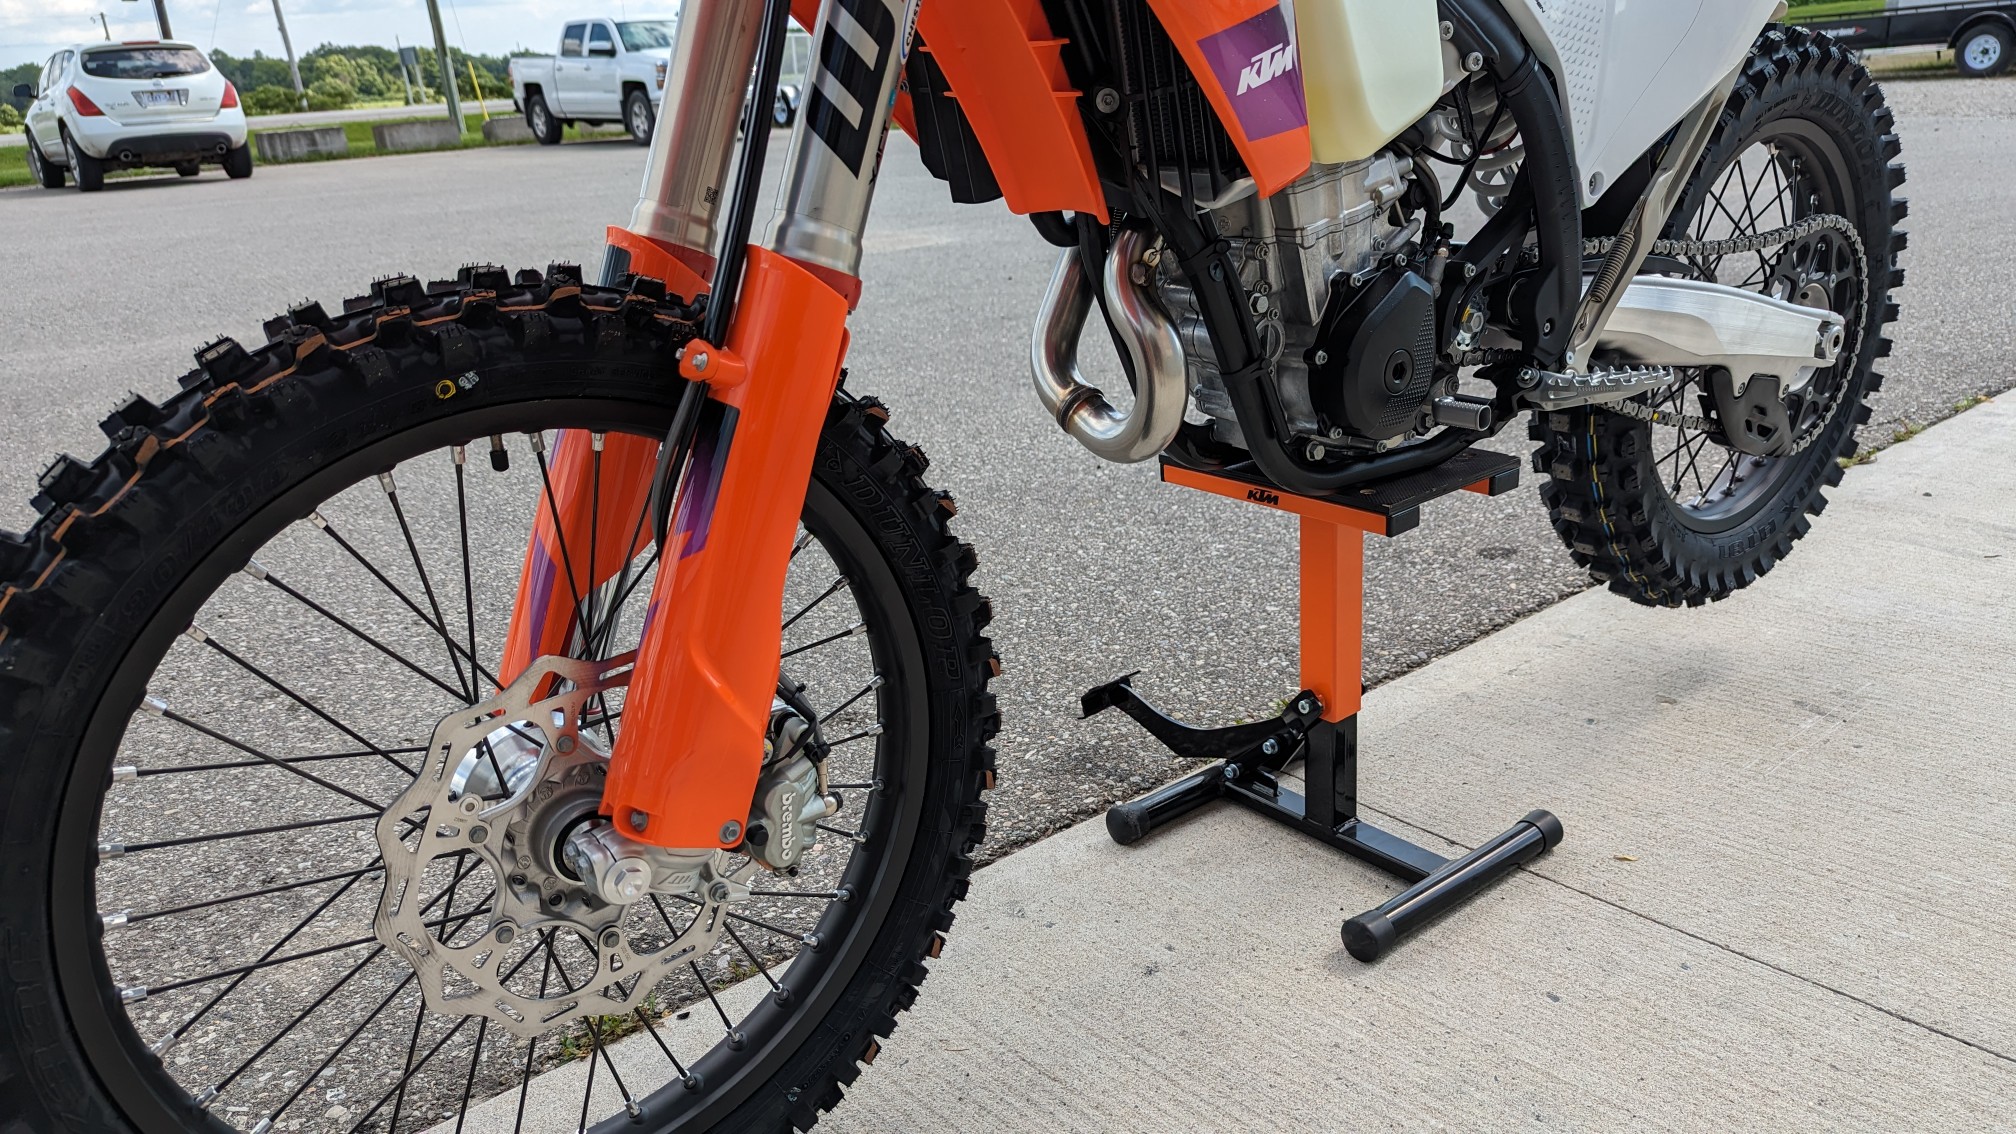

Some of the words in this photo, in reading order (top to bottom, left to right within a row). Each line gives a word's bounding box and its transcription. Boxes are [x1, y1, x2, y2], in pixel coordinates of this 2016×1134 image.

[905, 0, 922, 48] CHEST
[1236, 42, 1293, 97] KTM
[1246, 487, 1280, 505] KTM
[843, 470, 962, 681] DUNLOP
[781, 791, 797, 861] brembo
